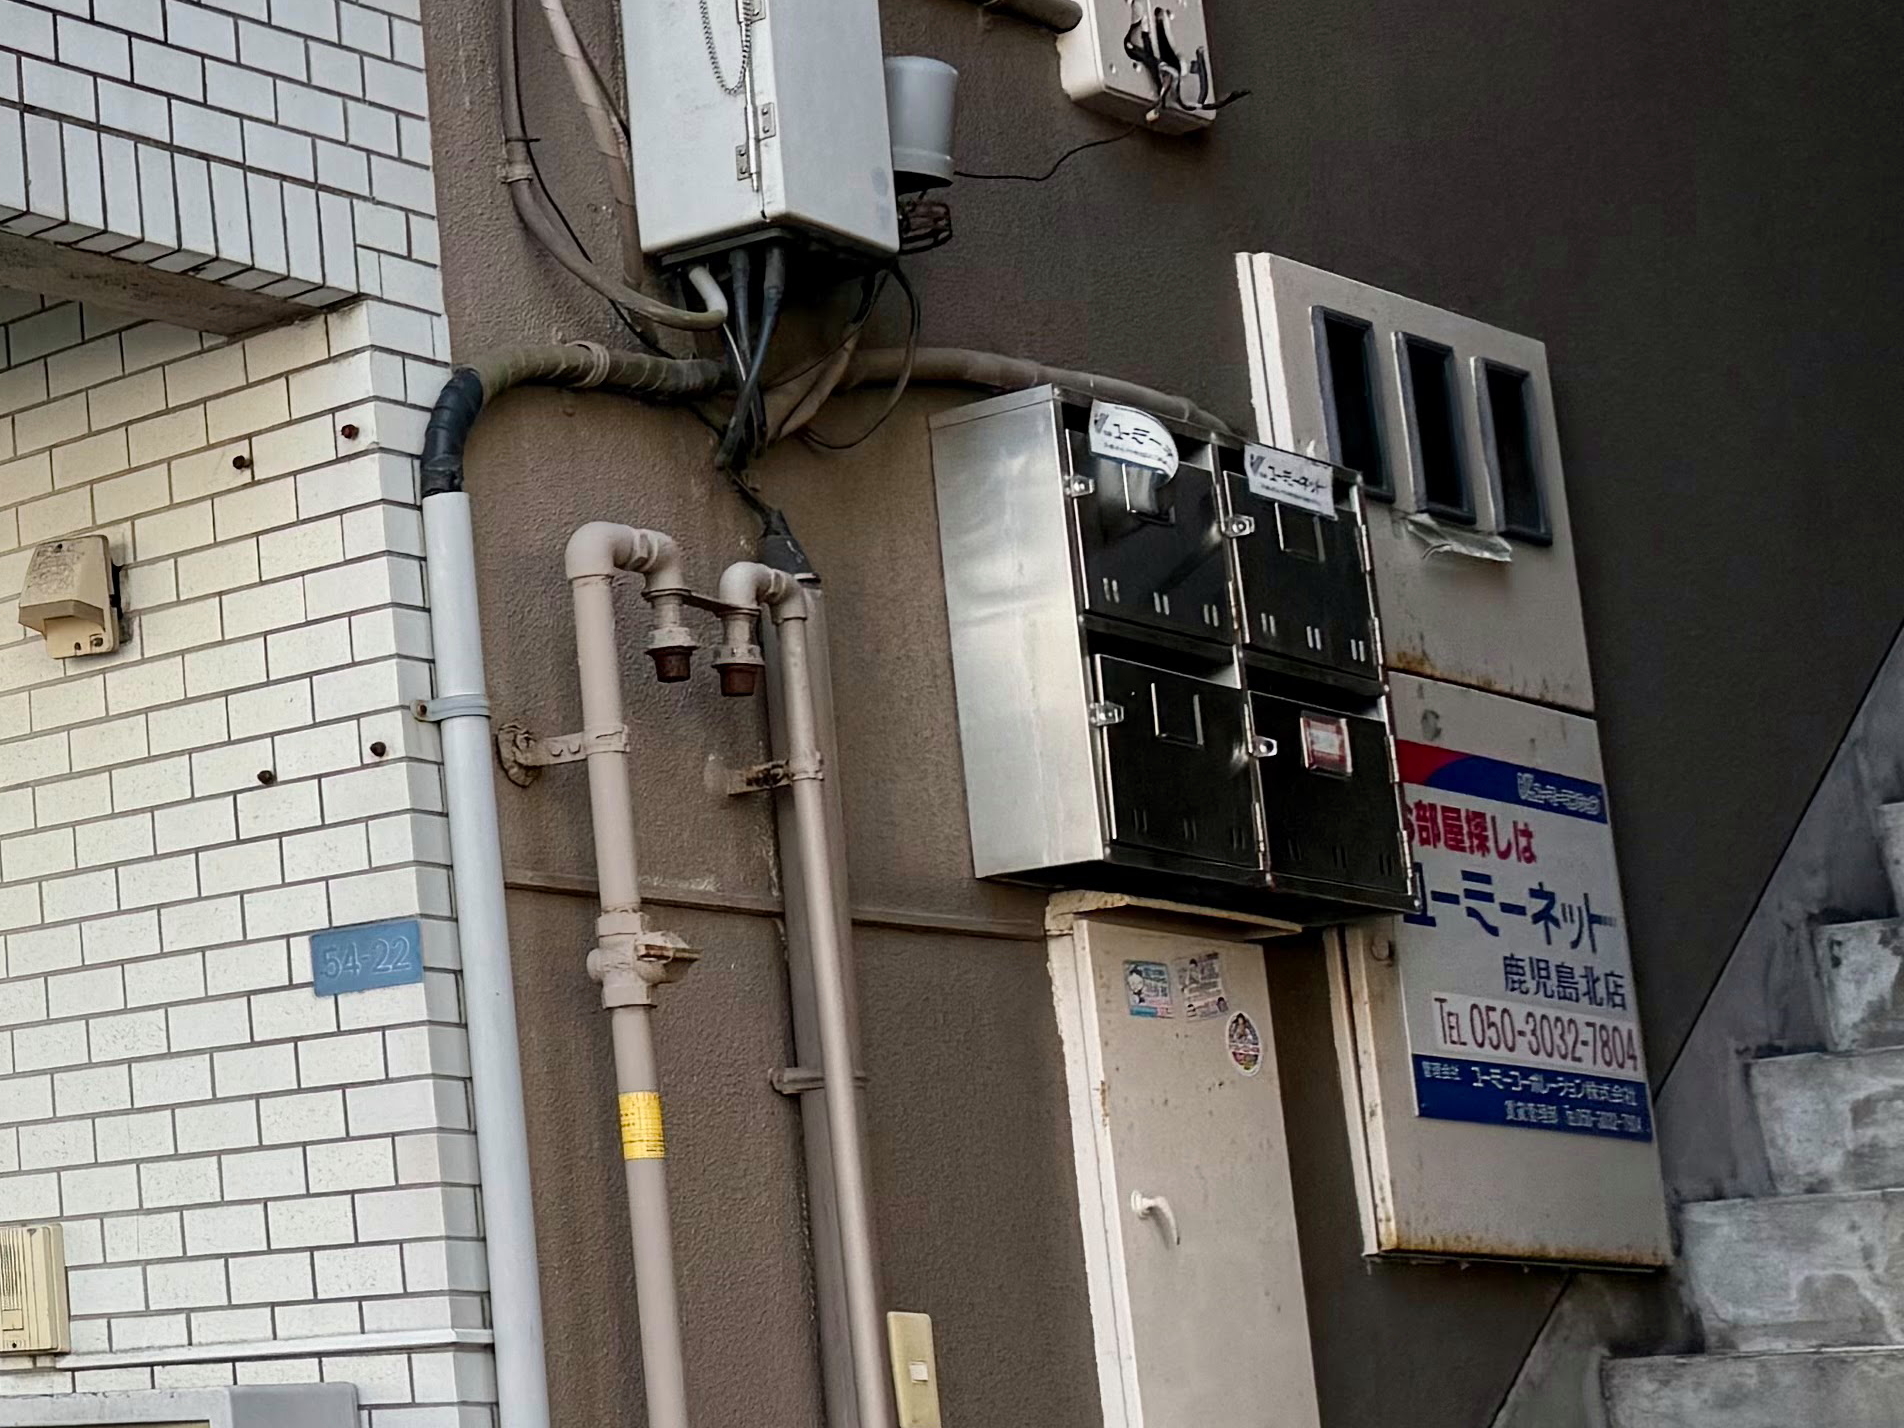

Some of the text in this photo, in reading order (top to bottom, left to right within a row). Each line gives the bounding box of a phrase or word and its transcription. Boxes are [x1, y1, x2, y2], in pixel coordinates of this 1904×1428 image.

[323, 934, 414, 981] 54-22
[1502, 953, 1627, 1012] 鹿児島北店
[1469, 1002, 1638, 1072] 050-3032-7804
